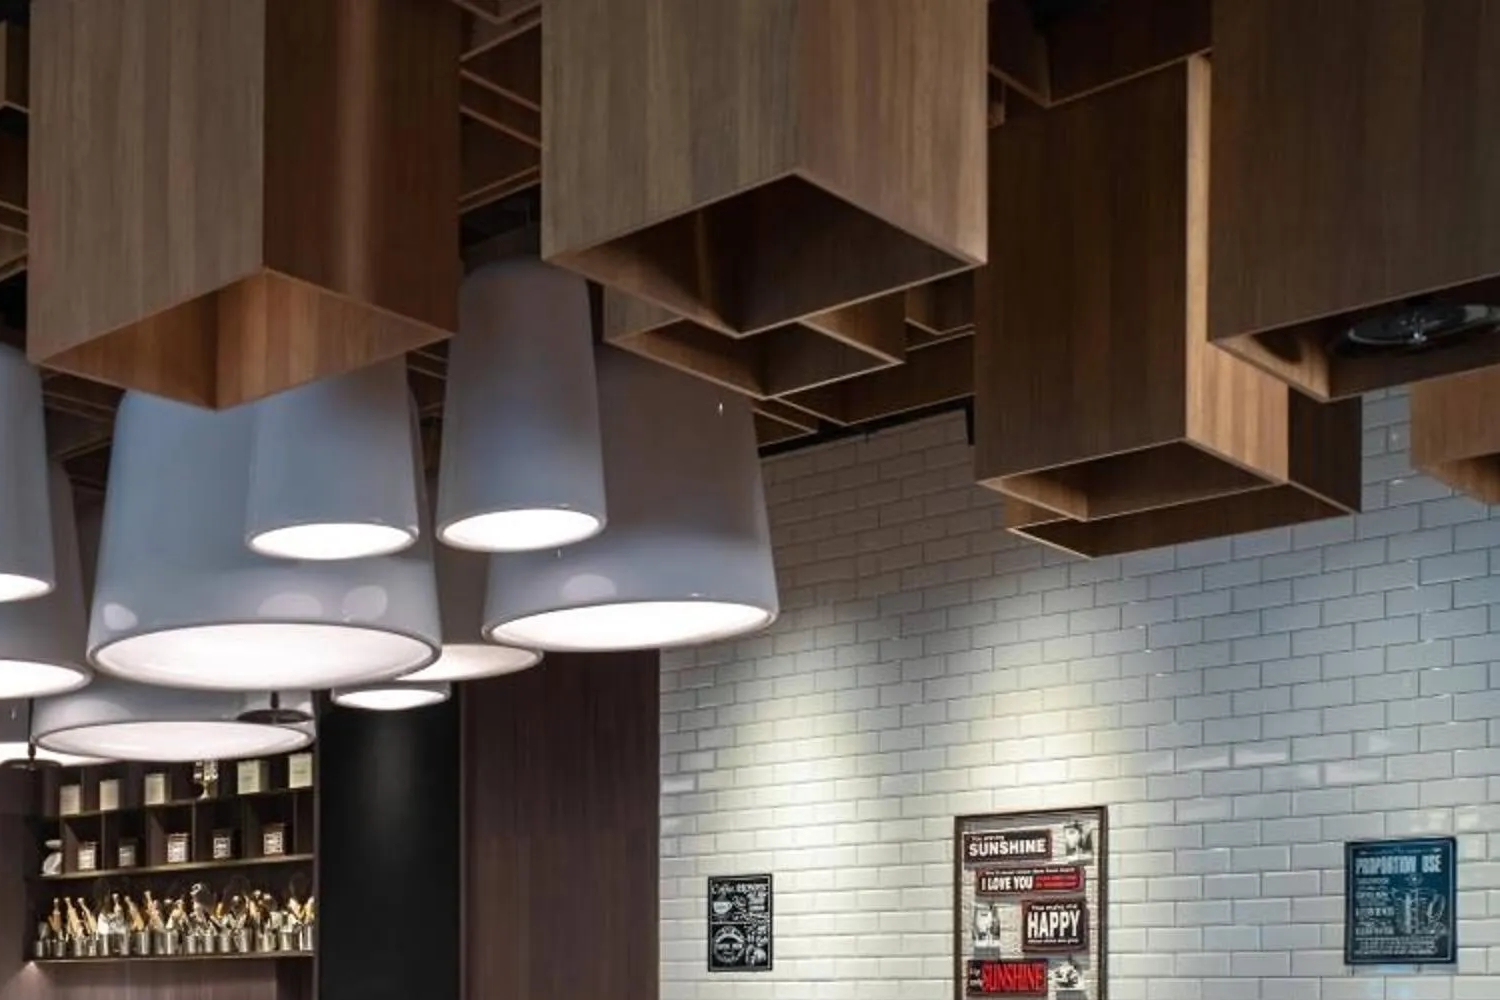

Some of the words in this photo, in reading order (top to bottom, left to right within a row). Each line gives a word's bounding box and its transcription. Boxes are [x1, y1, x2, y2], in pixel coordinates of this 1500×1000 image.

[969, 838, 1047, 857] SUNSHINE
[981, 877, 986, 891] I
[988, 877, 1011, 891] LOVE
[1014, 875, 1033, 890] YOU
[1027, 910, 1080, 938] HAPPY
